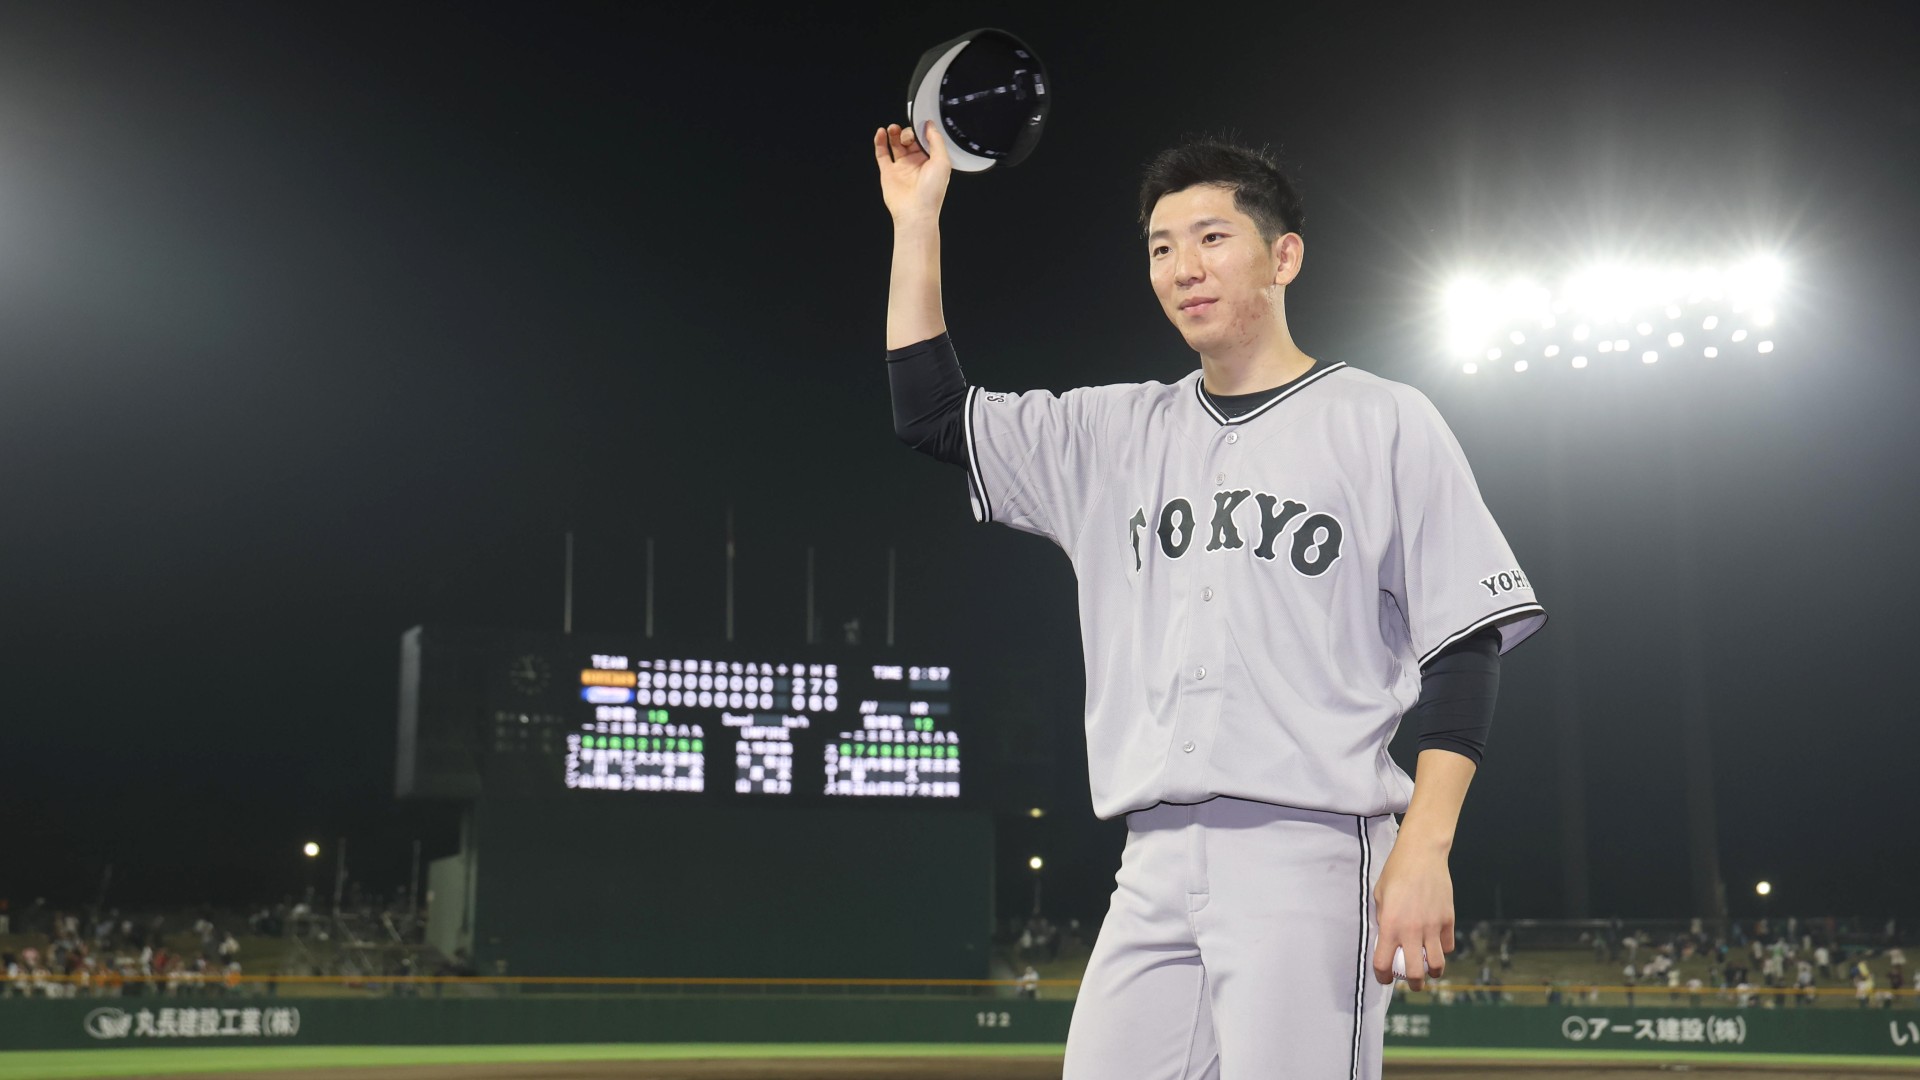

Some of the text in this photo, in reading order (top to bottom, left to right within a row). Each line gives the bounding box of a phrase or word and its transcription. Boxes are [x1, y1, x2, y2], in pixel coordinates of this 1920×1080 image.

[1129, 488, 1344, 579] TOKYO
[1587, 1015, 1746, 1044] アース建設(株)
